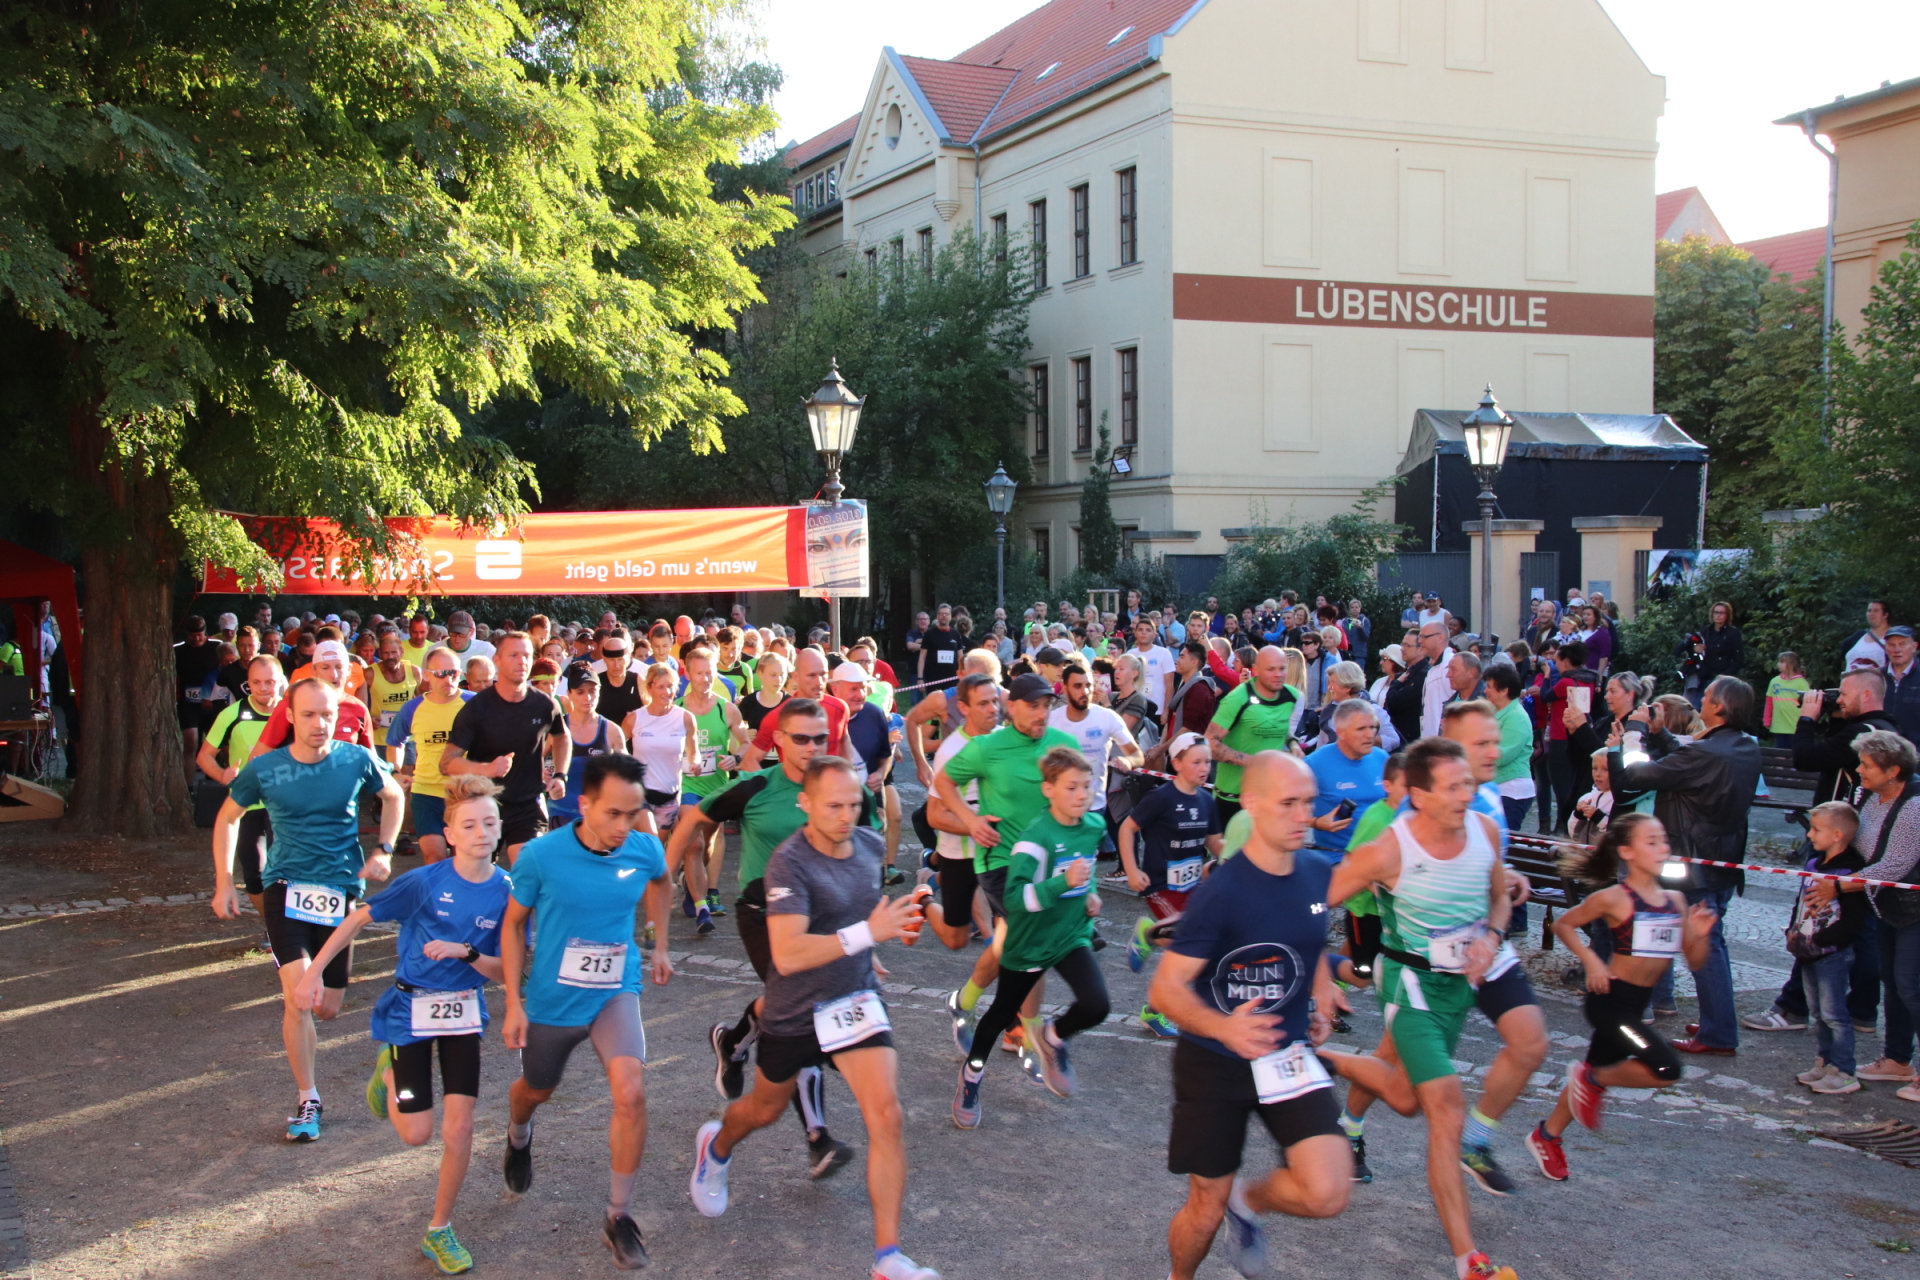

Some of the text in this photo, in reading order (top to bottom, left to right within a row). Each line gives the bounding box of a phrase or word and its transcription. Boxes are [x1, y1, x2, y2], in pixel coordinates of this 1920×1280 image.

[1296, 282, 1548, 327] LÜBENSCHULE
[188, 690, 201, 698] 16
[257, 751, 341, 788] CRAFT
[293, 891, 340, 914] 1639
[580, 956, 612, 973] 213
[1228, 964, 1283, 982] RUN
[1228, 982, 1284, 1001] MDB
[430, 1002, 463, 1019] 229
[831, 1005, 864, 1028] 198
